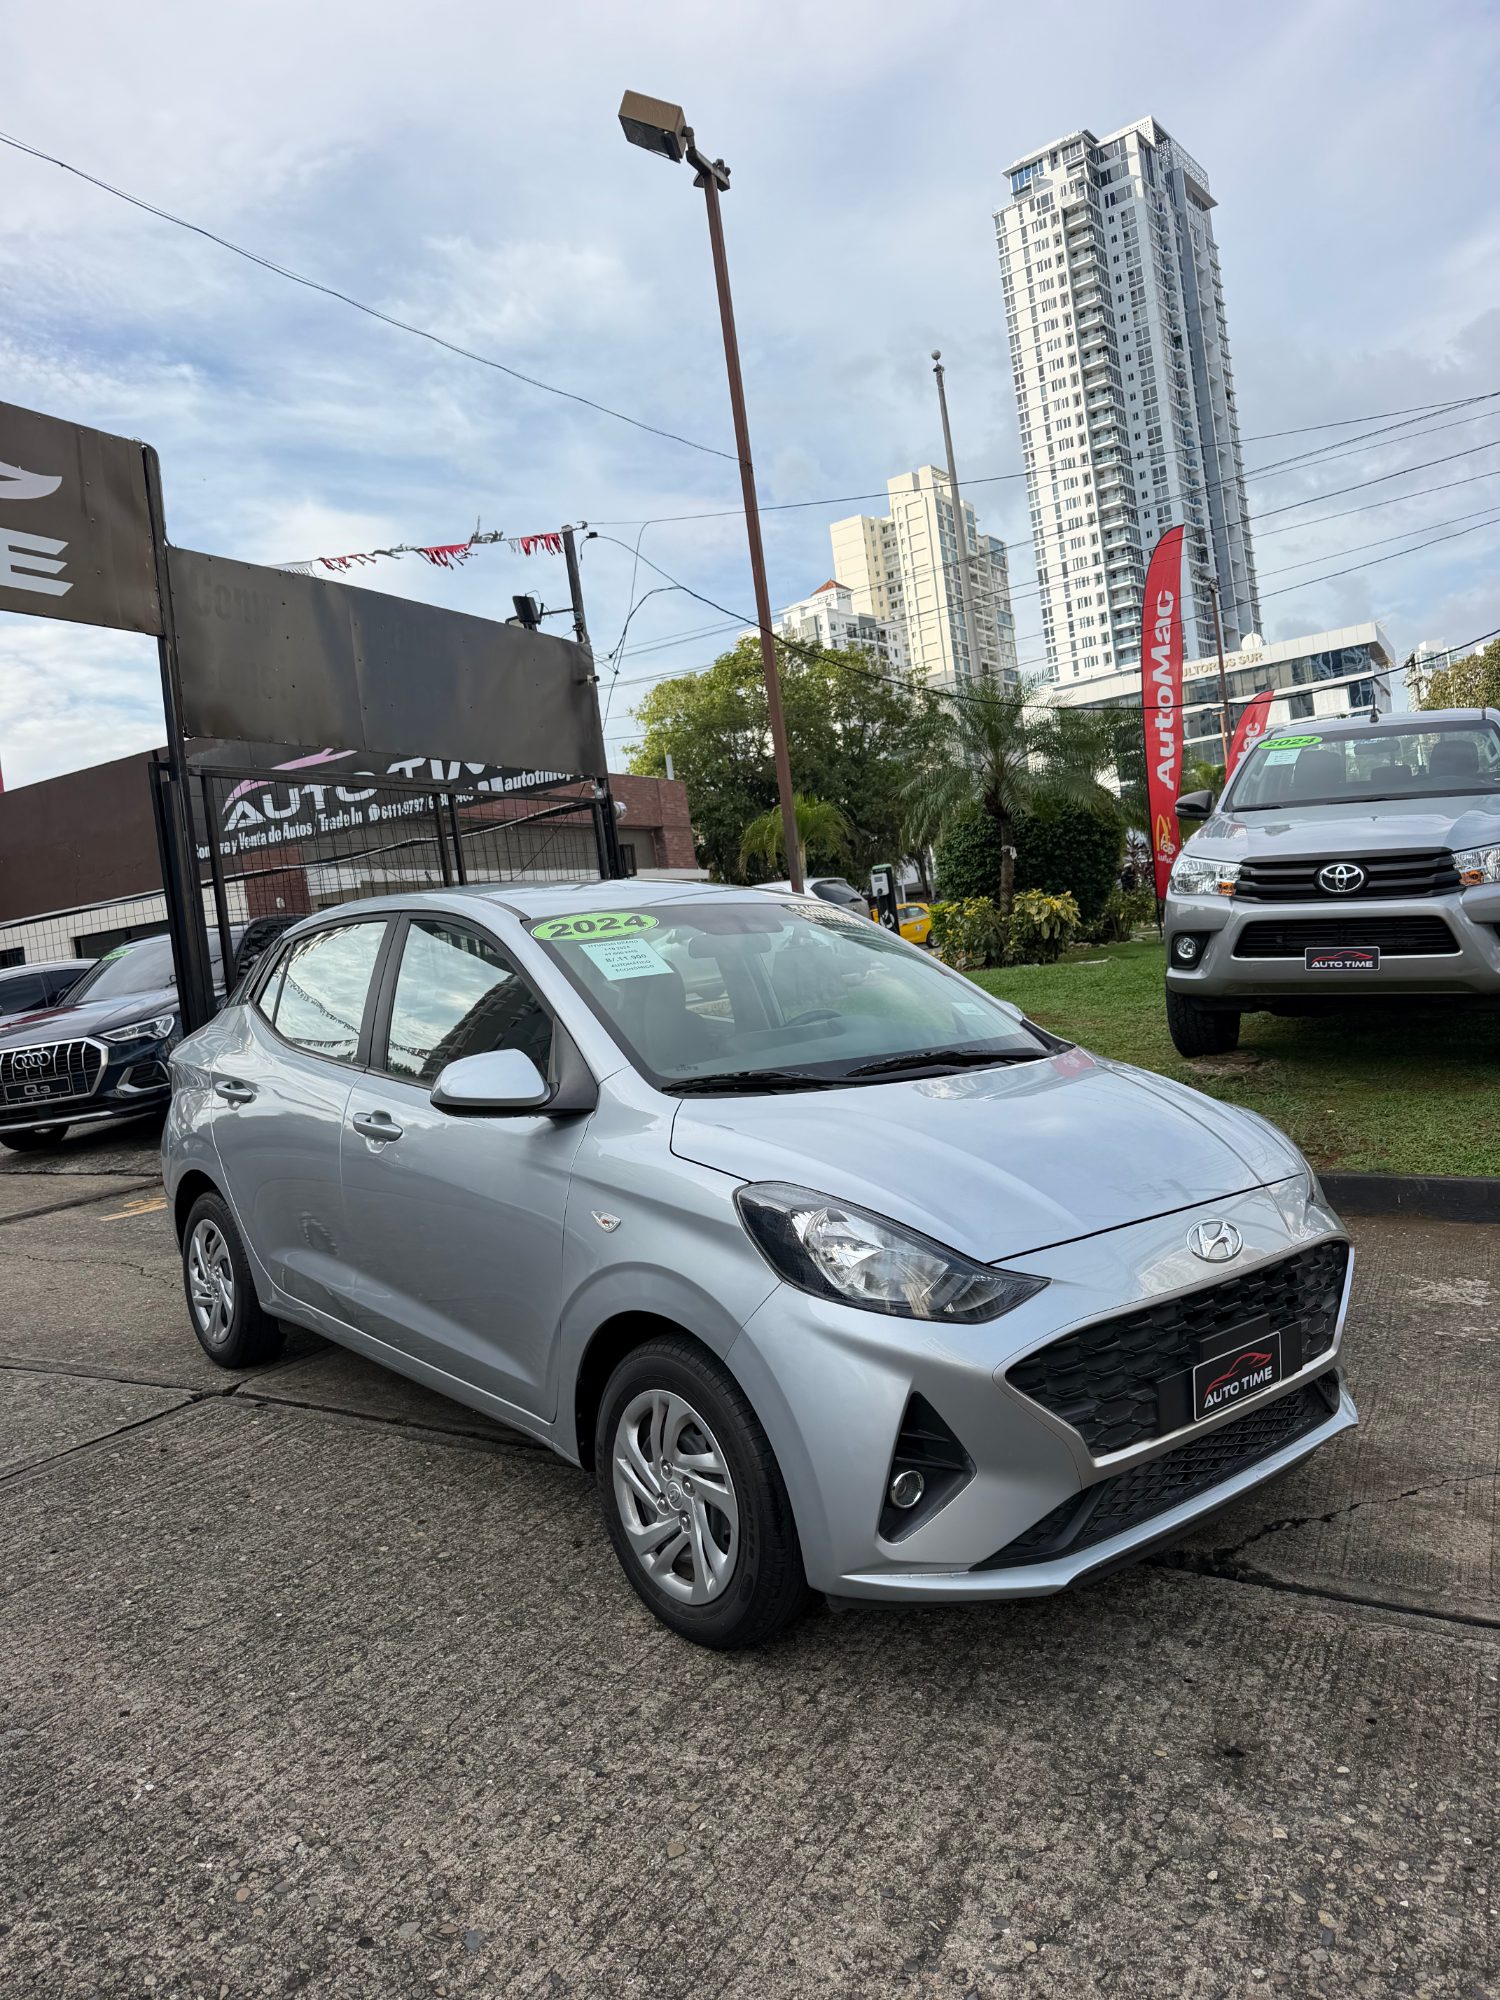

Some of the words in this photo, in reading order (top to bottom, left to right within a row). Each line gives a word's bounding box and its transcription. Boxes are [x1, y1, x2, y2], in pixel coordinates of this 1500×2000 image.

[1238, 652, 1263, 665] SUR
[1150, 590, 1175, 791] AutoMac
[1264, 737, 1317, 748] 2024
[224, 771, 378, 832] AUTO
[238, 831, 267, 850] Venta
[268, 826, 282, 842] de
[283, 821, 313, 840] Autos
[318, 809, 351, 832] Trade
[351, 806, 363, 824] In
[548, 915, 648, 938] 2024
[1344, 960, 1373, 968] TIME
[1204, 1381, 1240, 1409] AUTO
[1241, 1365, 1273, 1390] TIME
